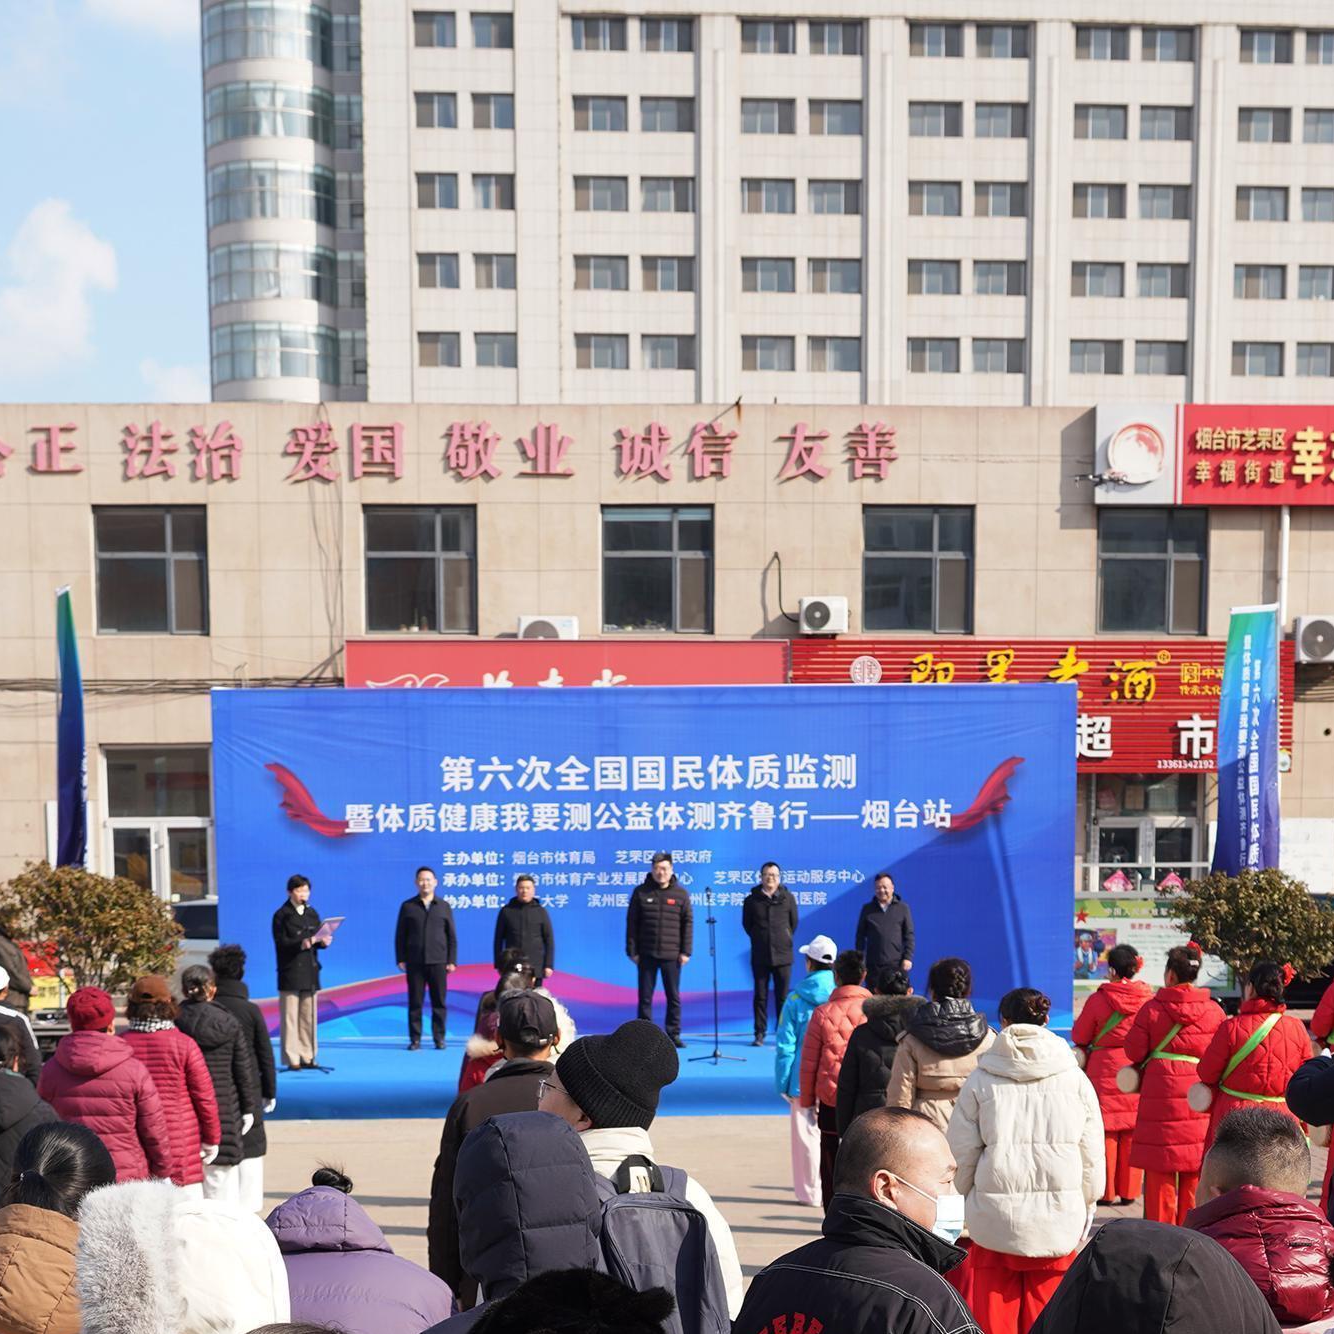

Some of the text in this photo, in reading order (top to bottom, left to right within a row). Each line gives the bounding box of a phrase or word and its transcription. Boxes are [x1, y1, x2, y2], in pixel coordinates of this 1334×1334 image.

[123, 421, 243, 479] 法治
[286, 422, 405, 481] 爱国
[445, 420, 575, 479] 敬业
[618, 421, 738, 480] 诚信
[777, 420, 899, 480] 友善
[1196, 427, 1287, 451] 烟台市芝罘区
[1196, 459, 1287, 484] 幸福街道
[439, 754, 857, 793] 第六次全国国民体质监测
[345, 798, 952, 834] 暨体质健康我要测公益体测齐鲁行——烟台站
[615, 850, 712, 865] 芝罘区民政府
